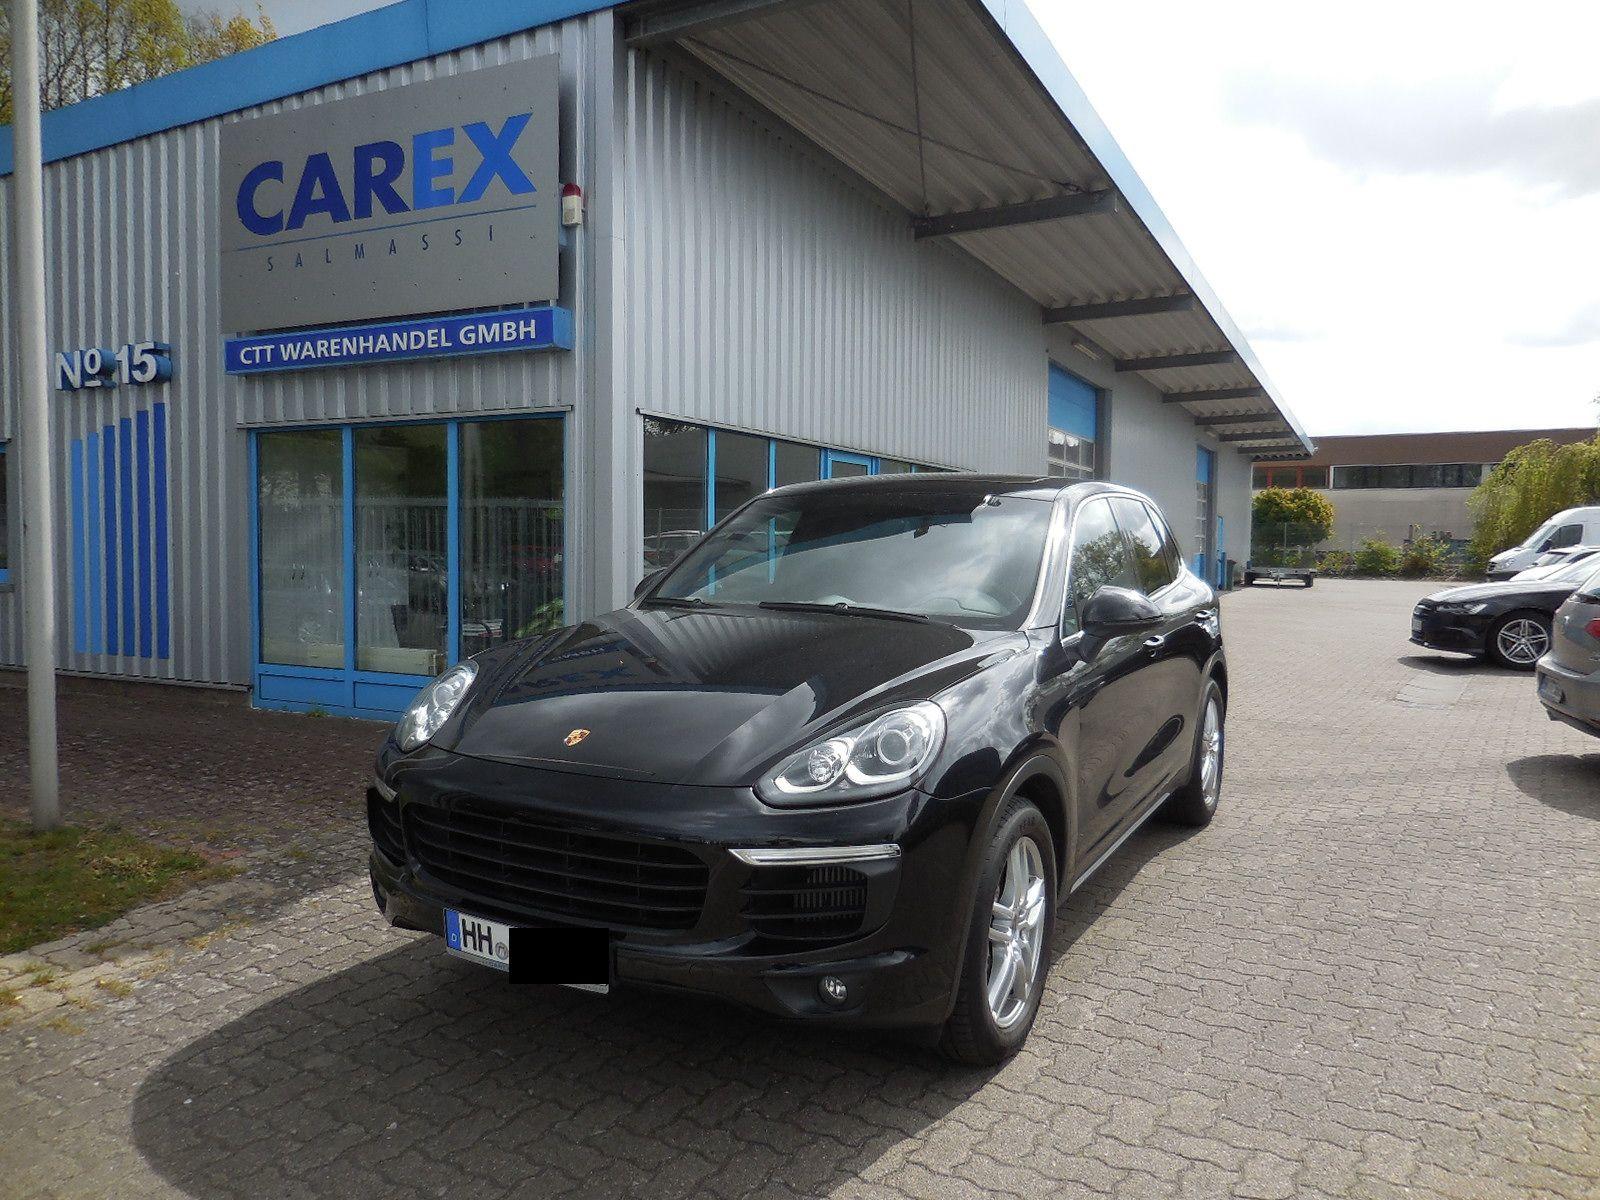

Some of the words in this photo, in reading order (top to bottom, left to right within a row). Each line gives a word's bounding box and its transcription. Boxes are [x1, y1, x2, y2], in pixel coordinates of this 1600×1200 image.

[236, 112, 538, 236] CAREX
[266, 224, 494, 272] SALMASSI
[115, 341, 158, 384] 15
[239, 344, 275, 366] CTT
[280, 327, 453, 362] WARENHANDEL
[458, 318, 537, 346] GMBH
[450, 932, 459, 943] D
[461, 918, 494, 956] HH
